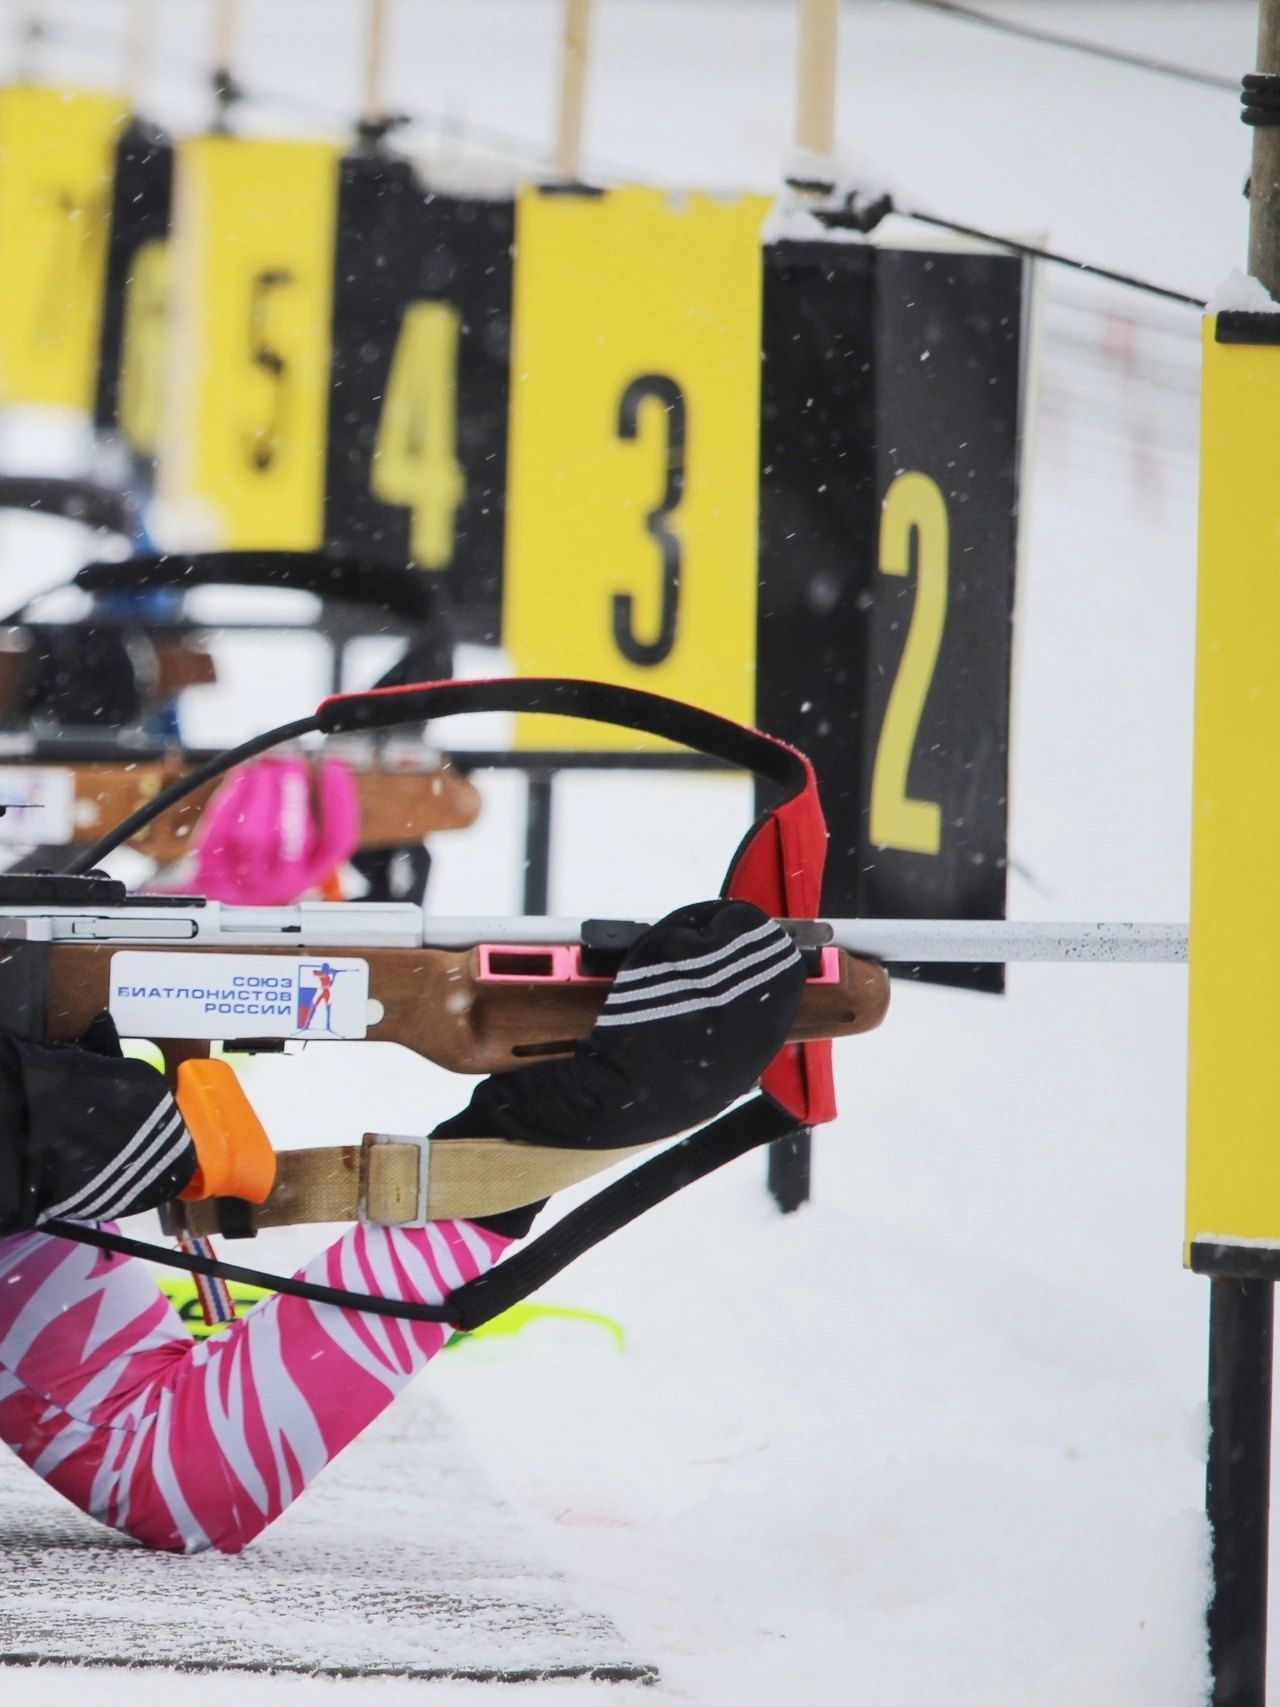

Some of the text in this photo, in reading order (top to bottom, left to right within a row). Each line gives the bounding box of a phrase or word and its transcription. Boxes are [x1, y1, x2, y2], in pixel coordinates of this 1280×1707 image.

[240, 266, 293, 474] 5
[370, 300, 466, 570] 4
[611, 372, 687, 668] 3
[869, 471, 949, 856] 2
[117, 986, 293, 1002] БИАТЛОНИСТОВ
[204, 1003, 292, 1016] РОССИИ
[232, 976, 293, 989] СОЮЗ
